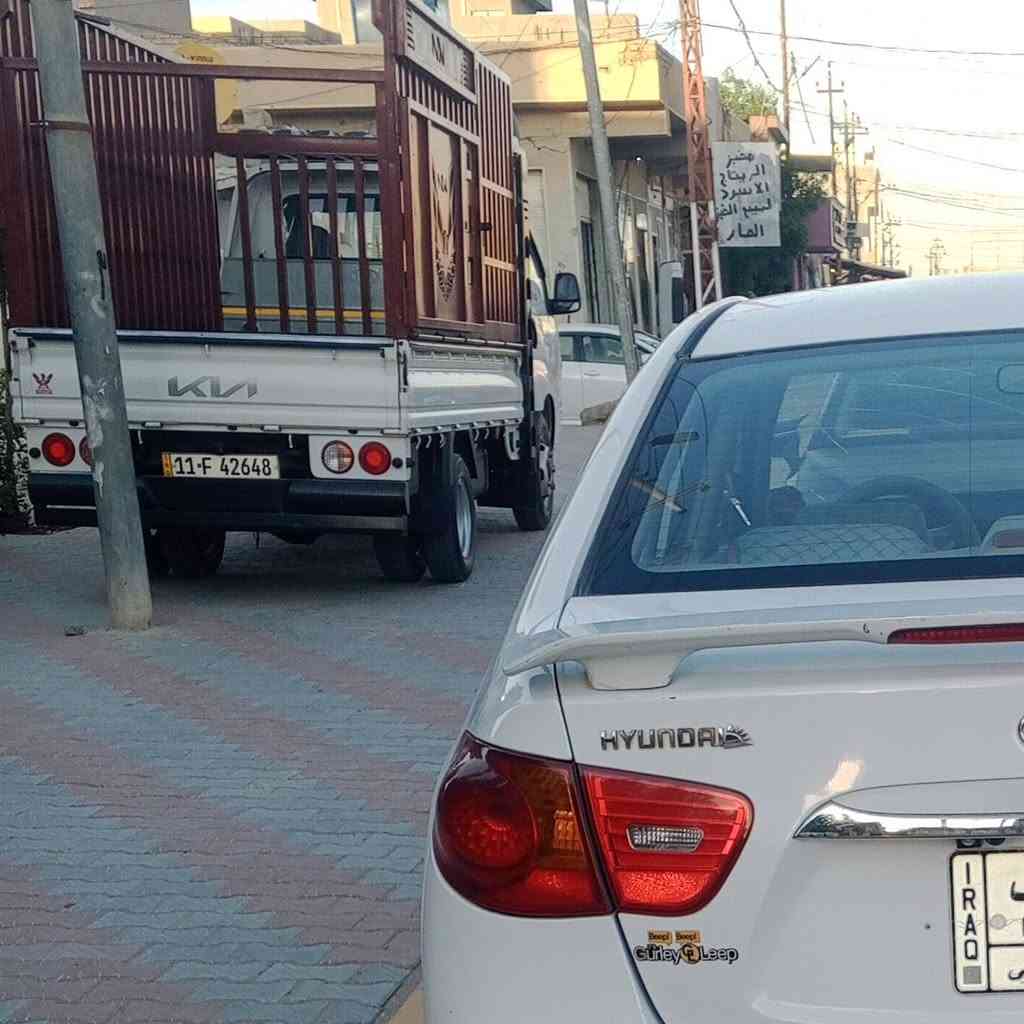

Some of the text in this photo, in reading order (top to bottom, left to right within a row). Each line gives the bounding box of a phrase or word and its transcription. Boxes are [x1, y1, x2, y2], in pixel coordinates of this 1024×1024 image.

[219, 457, 273, 477] 42648
[600, 727, 725, 751] HYUNDAI
[962, 861, 979, 961] IRAQ
